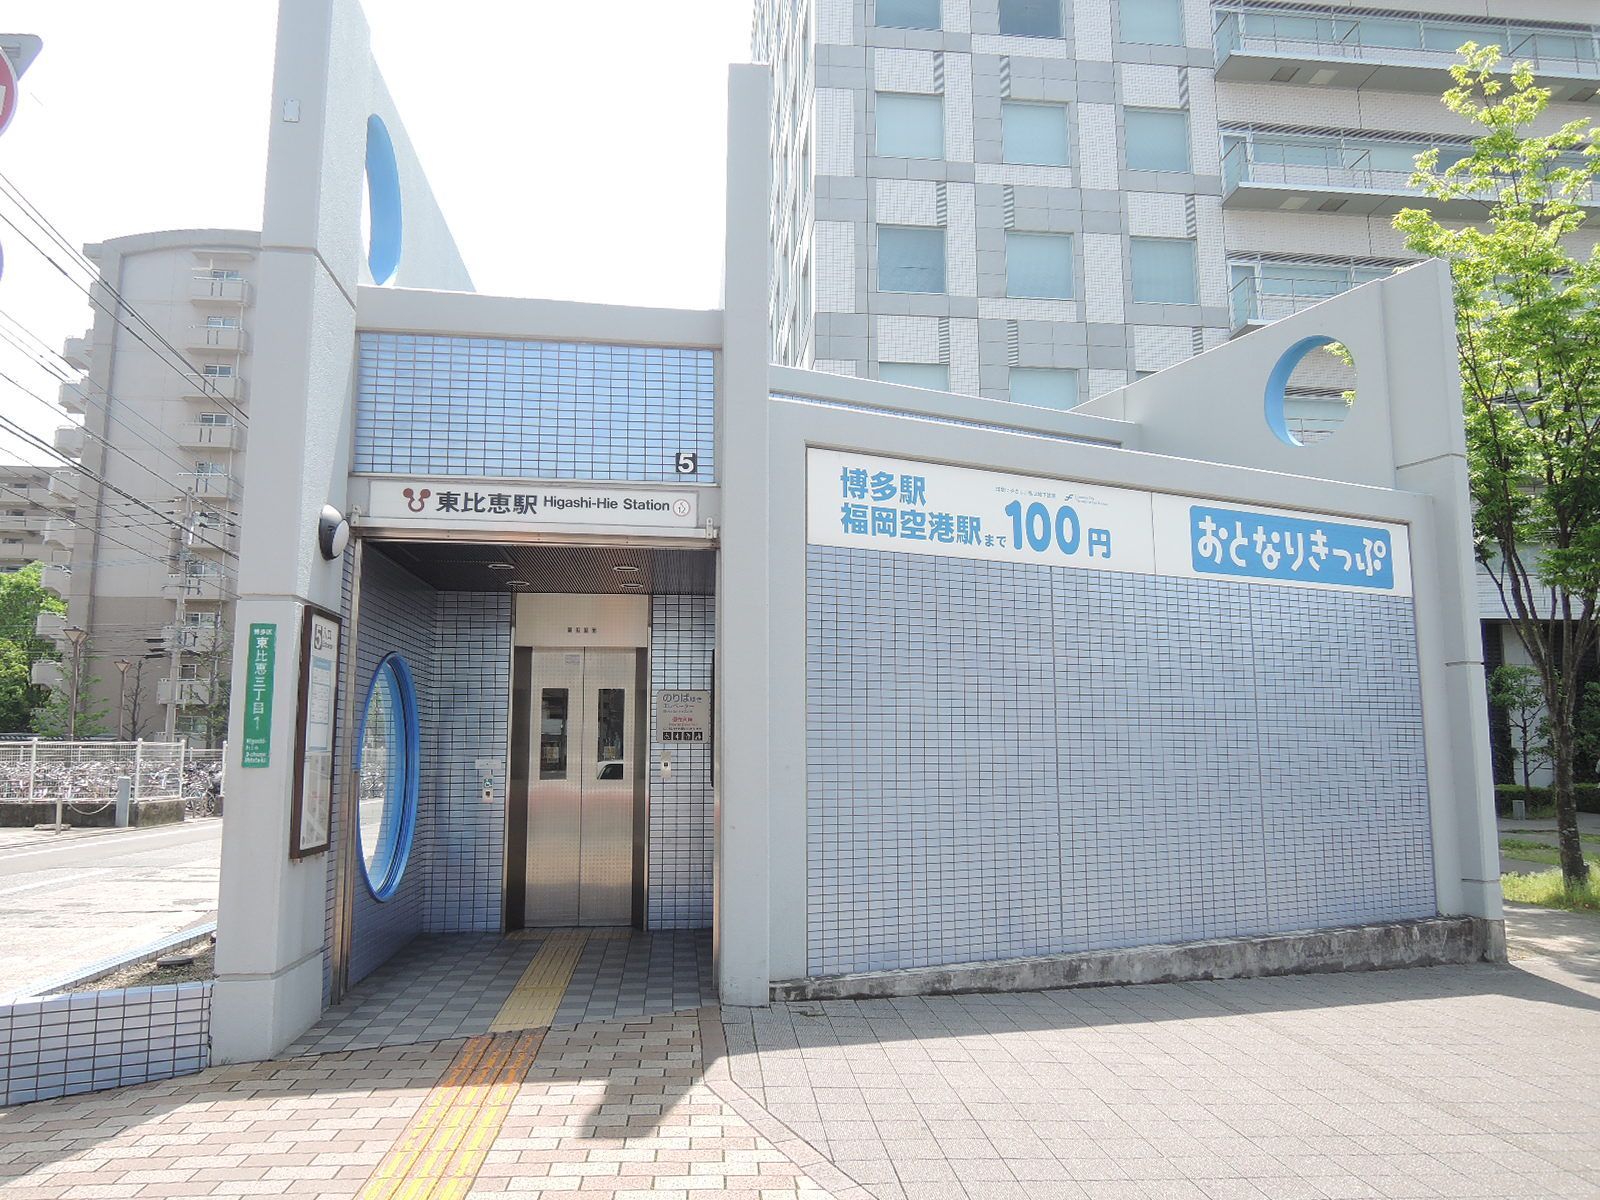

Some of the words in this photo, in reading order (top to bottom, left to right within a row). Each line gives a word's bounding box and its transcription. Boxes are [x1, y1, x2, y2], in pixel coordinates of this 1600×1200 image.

[679, 455, 693, 472] 5
[840, 466, 926, 507] 博多駅
[436, 491, 538, 515] 東比恵駅
[543, 495, 618, 512] Higashi-Hie
[623, 497, 670, 512] Station
[1197, 515, 1387, 576] おとなりきっぷ
